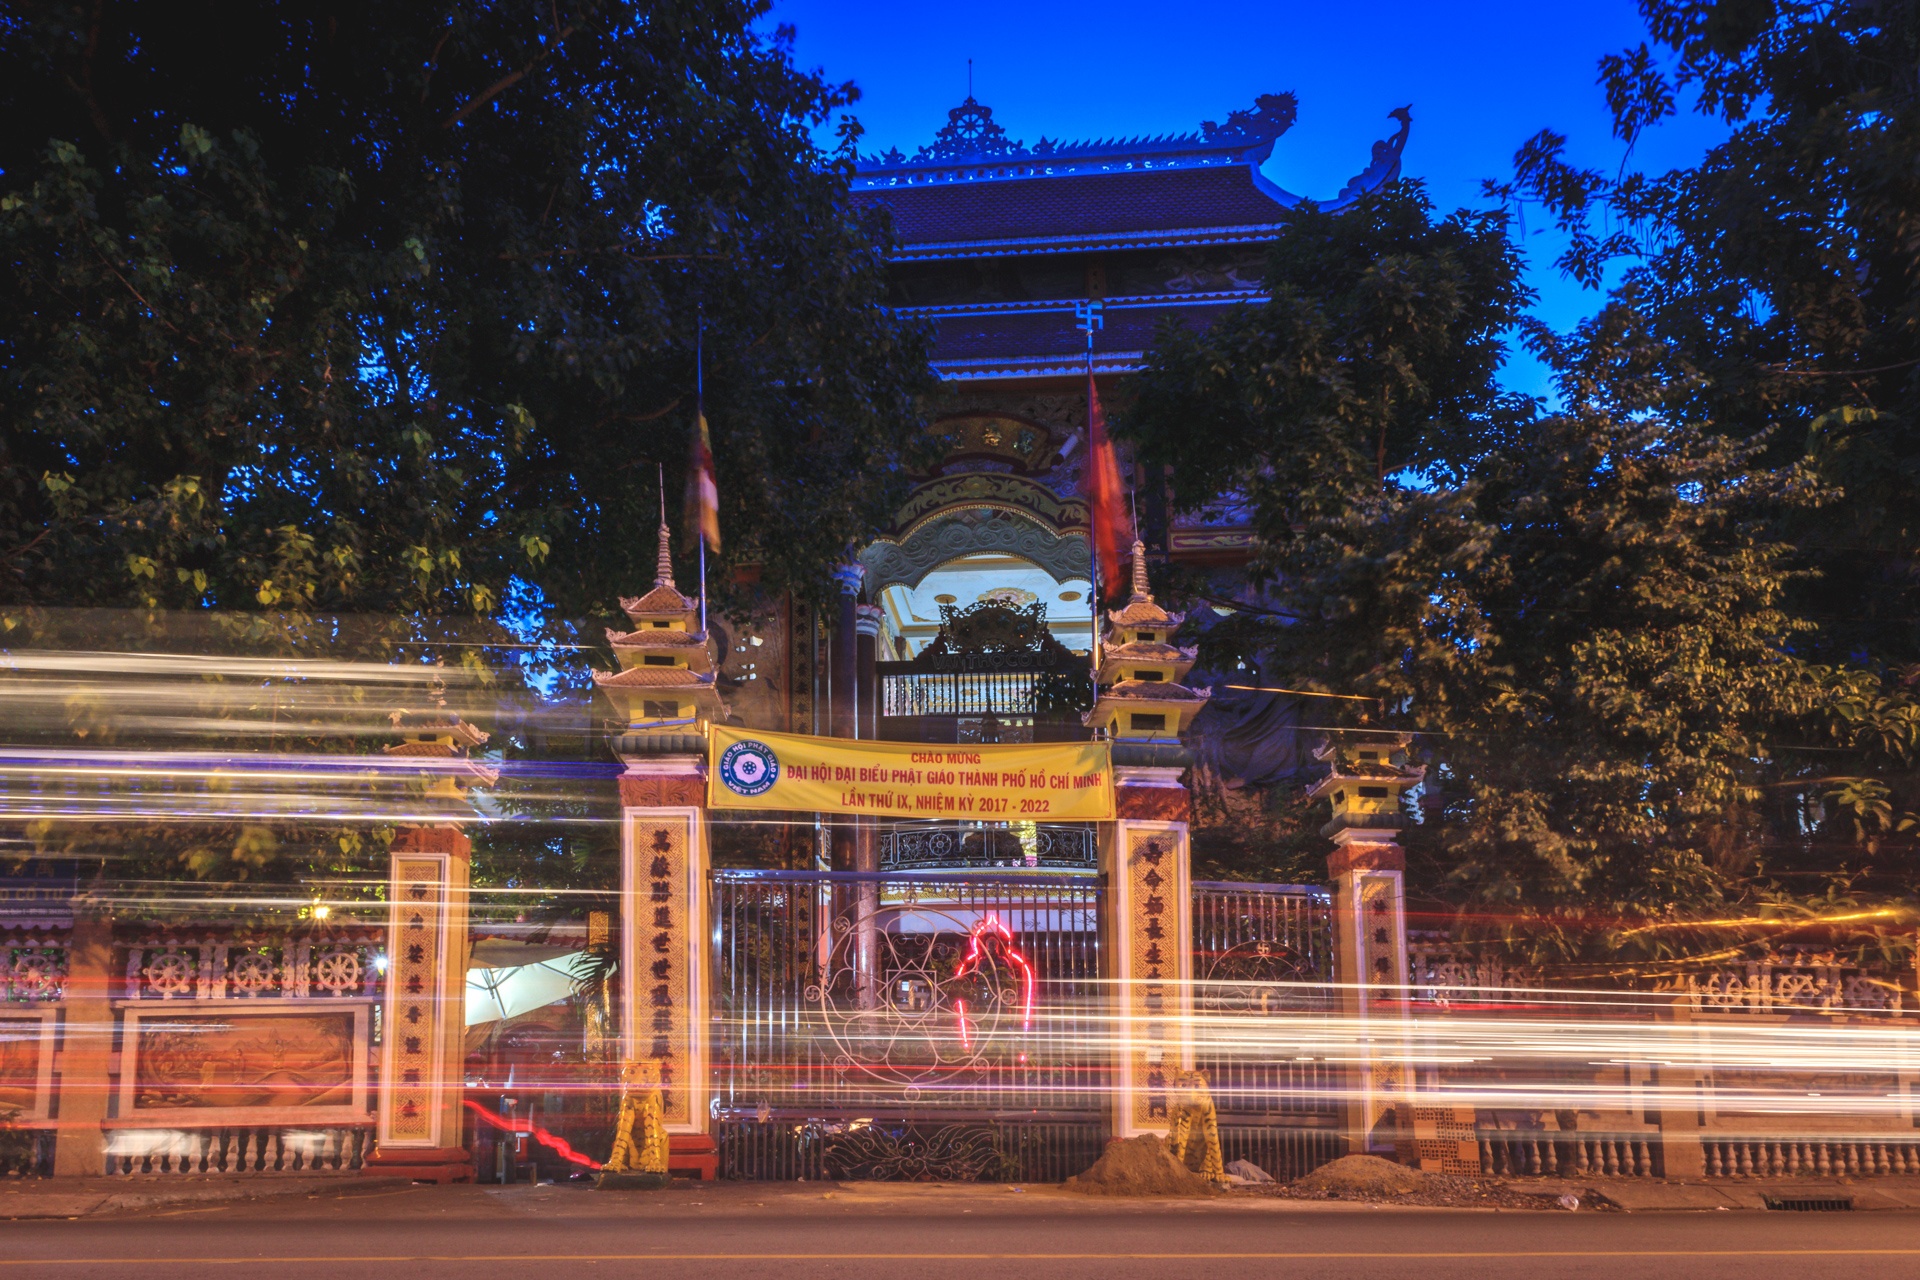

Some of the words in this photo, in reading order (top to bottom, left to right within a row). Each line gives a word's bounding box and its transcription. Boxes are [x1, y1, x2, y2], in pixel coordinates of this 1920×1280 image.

[723, 752, 733, 770] GIÁO
[732, 743, 746, 752] HỘI
[768, 754, 777, 773] GIÁO
[911, 750, 943, 764] CHÀO
[946, 751, 981, 764] MỪNG
[750, 781, 770, 794] NAM
[787, 765, 807, 782] ĐẠI
[811, 762, 831, 784] HỘI
[835, 766, 855, 784] ĐẠI
[860, 763, 888, 783] BIỂU
[892, 768, 923, 786] PHẬT
[927, 769, 955, 785] GIÁO
[958, 769, 998, 787] THÀNH
[1002, 768, 1027, 788] PHỐ
[1030, 768, 1046, 789] HỒ
[1050, 772, 1069, 789] CHÍ
[1073, 772, 1102, 789] MINH
[842, 787, 865, 807] LẦN
[869, 790, 894, 809] THỨ
[897, 795, 912, 812] IX,
[916, 792, 954, 813] NHIỆM
[958, 793, 974, 811] KỲ
[979, 797, 1008, 812] 2017
[1020, 799, 1050, 813] 2022
